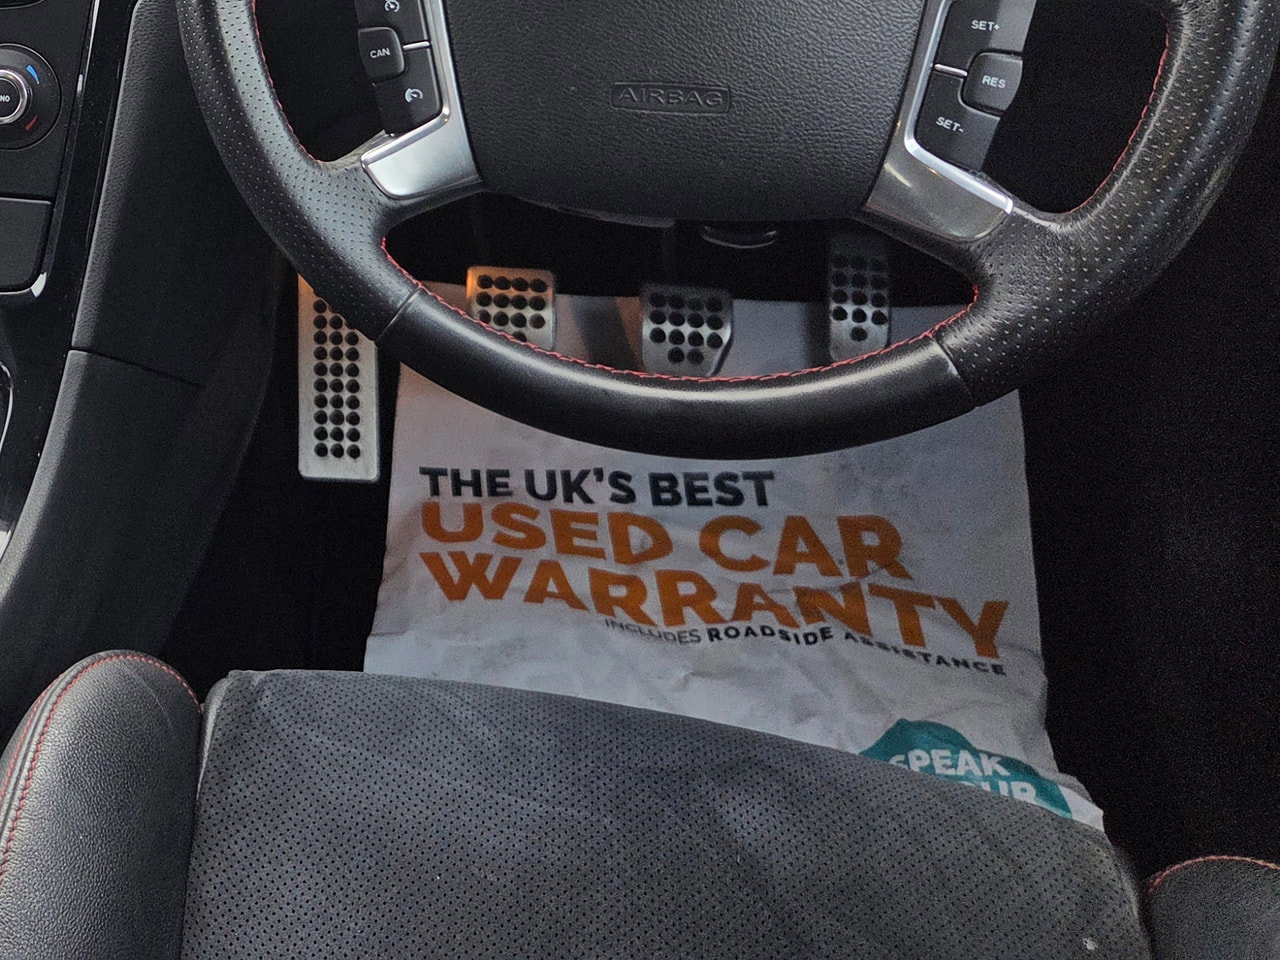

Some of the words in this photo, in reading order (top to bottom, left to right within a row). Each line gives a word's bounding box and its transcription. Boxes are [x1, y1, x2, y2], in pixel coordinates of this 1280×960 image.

[971, 19, 1001, 31] SET+
[370, 47, 391, 59] CAN
[982, 75, 1006, 89] RES
[619, 87, 723, 107] AIRBAG
[935, 115, 965, 135] SET-
[420, 467, 513, 498] THE
[524, 468, 637, 505] UK'S
[648, 470, 775, 507] BEST
[421, 500, 673, 566] USED
[699, 514, 914, 581] CAR
[420, 550, 1010, 660] WARRANTY
[604, 616, 702, 645] INCLUDES
[707, 625, 834, 646] ROADSIDE
[843, 630, 1008, 677] ASSISTANCE
